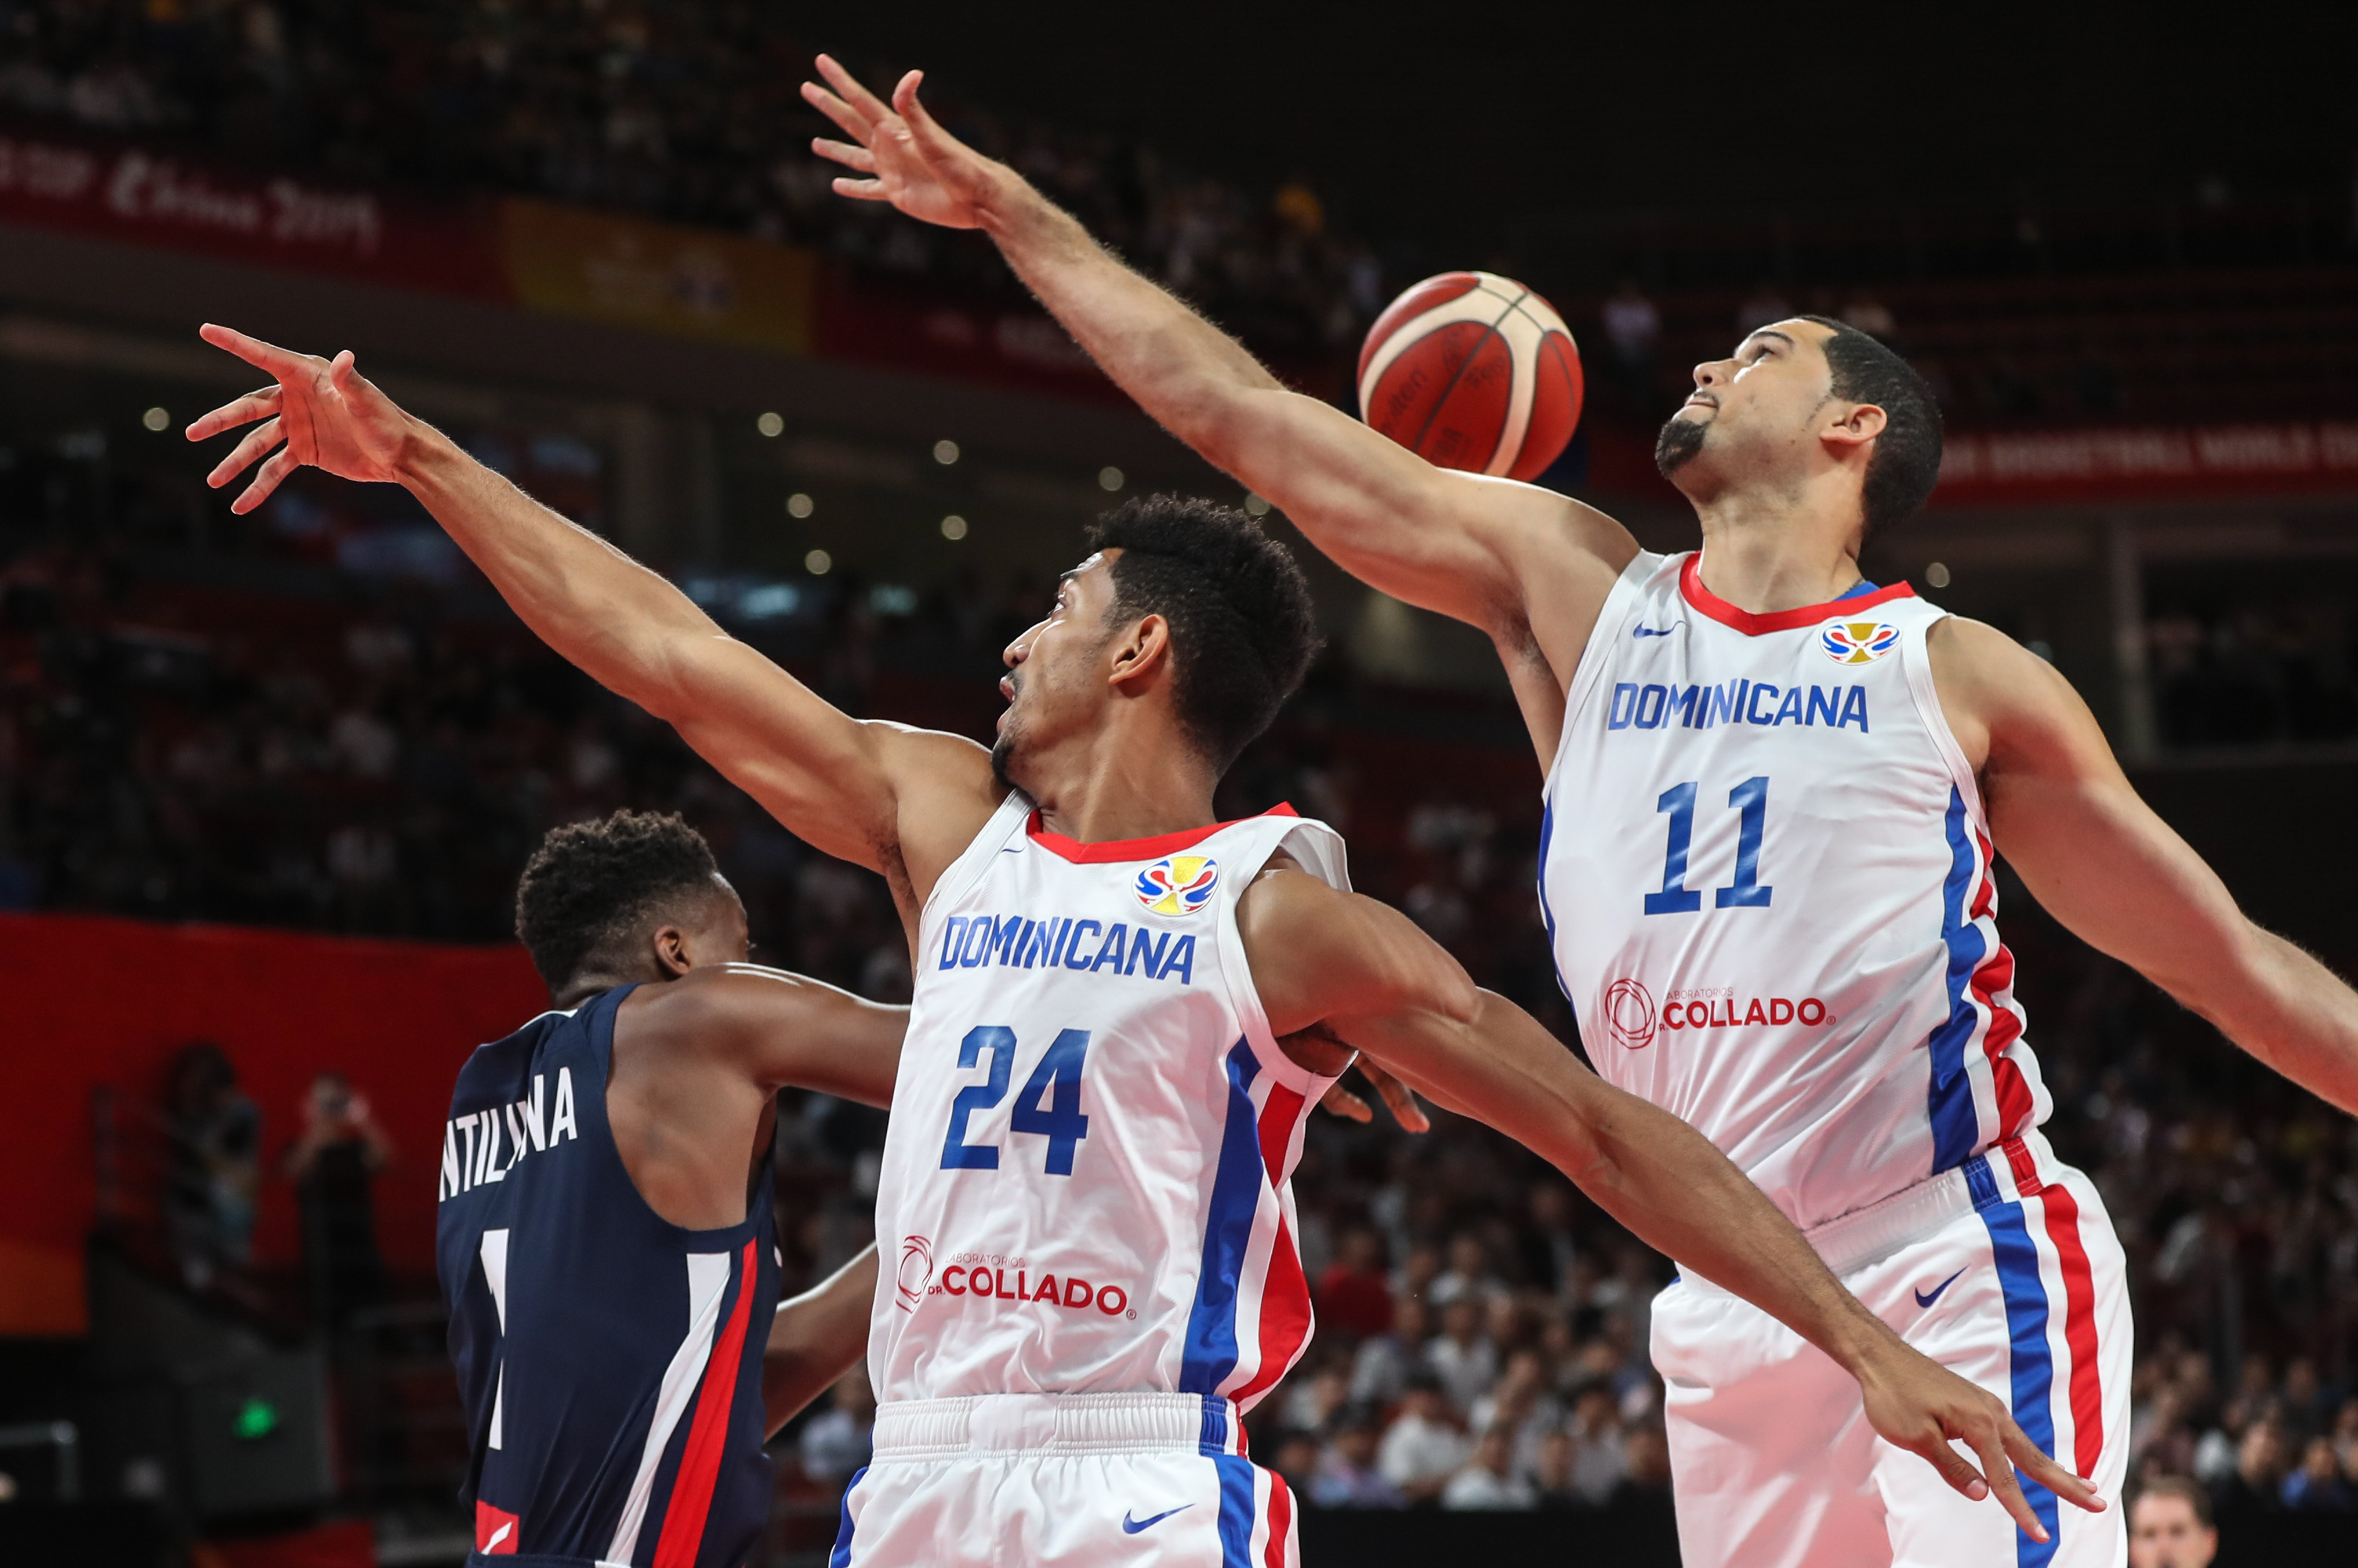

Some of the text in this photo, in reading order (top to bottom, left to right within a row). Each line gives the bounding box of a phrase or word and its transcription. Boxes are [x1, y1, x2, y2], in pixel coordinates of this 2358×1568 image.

[1608, 678, 1869, 734] DOMINICANA
[1645, 776, 1773, 915] 11
[938, 914, 1196, 985] DOMINICANA
[1666, 986, 1733, 1001] ABORATORIOS
[939, 1025, 1092, 1176] 24
[945, 1253, 1026, 1268] LABORATORIOS
